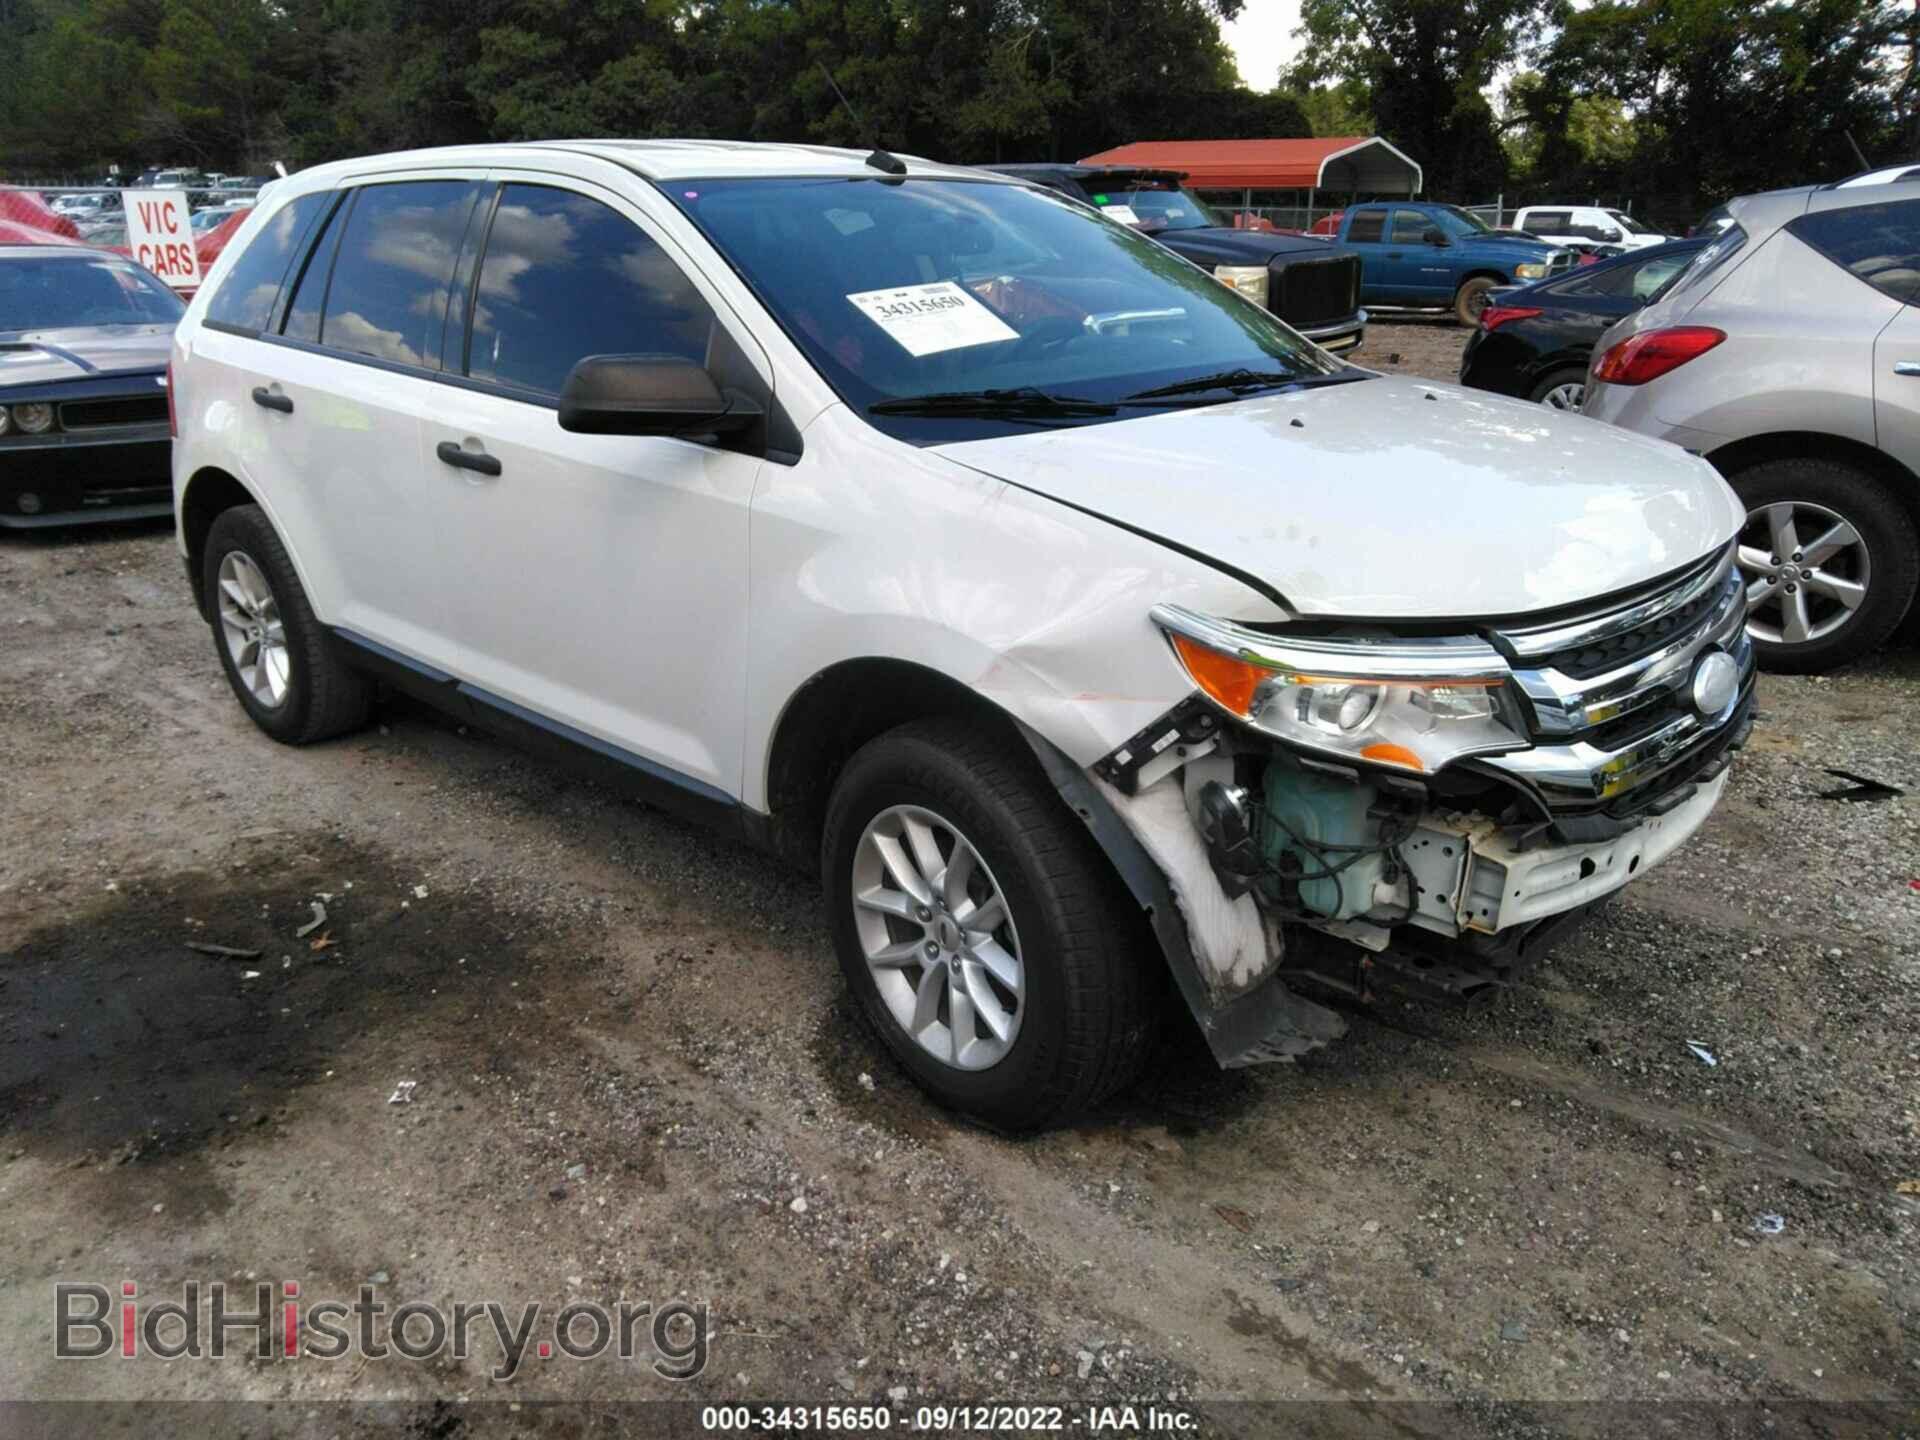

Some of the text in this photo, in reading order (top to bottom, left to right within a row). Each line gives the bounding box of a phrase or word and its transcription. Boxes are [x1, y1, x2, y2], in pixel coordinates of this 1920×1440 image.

[137, 201, 178, 234] VIC
[139, 242, 194, 276] CARS
[875, 295, 966, 319] 34315650
